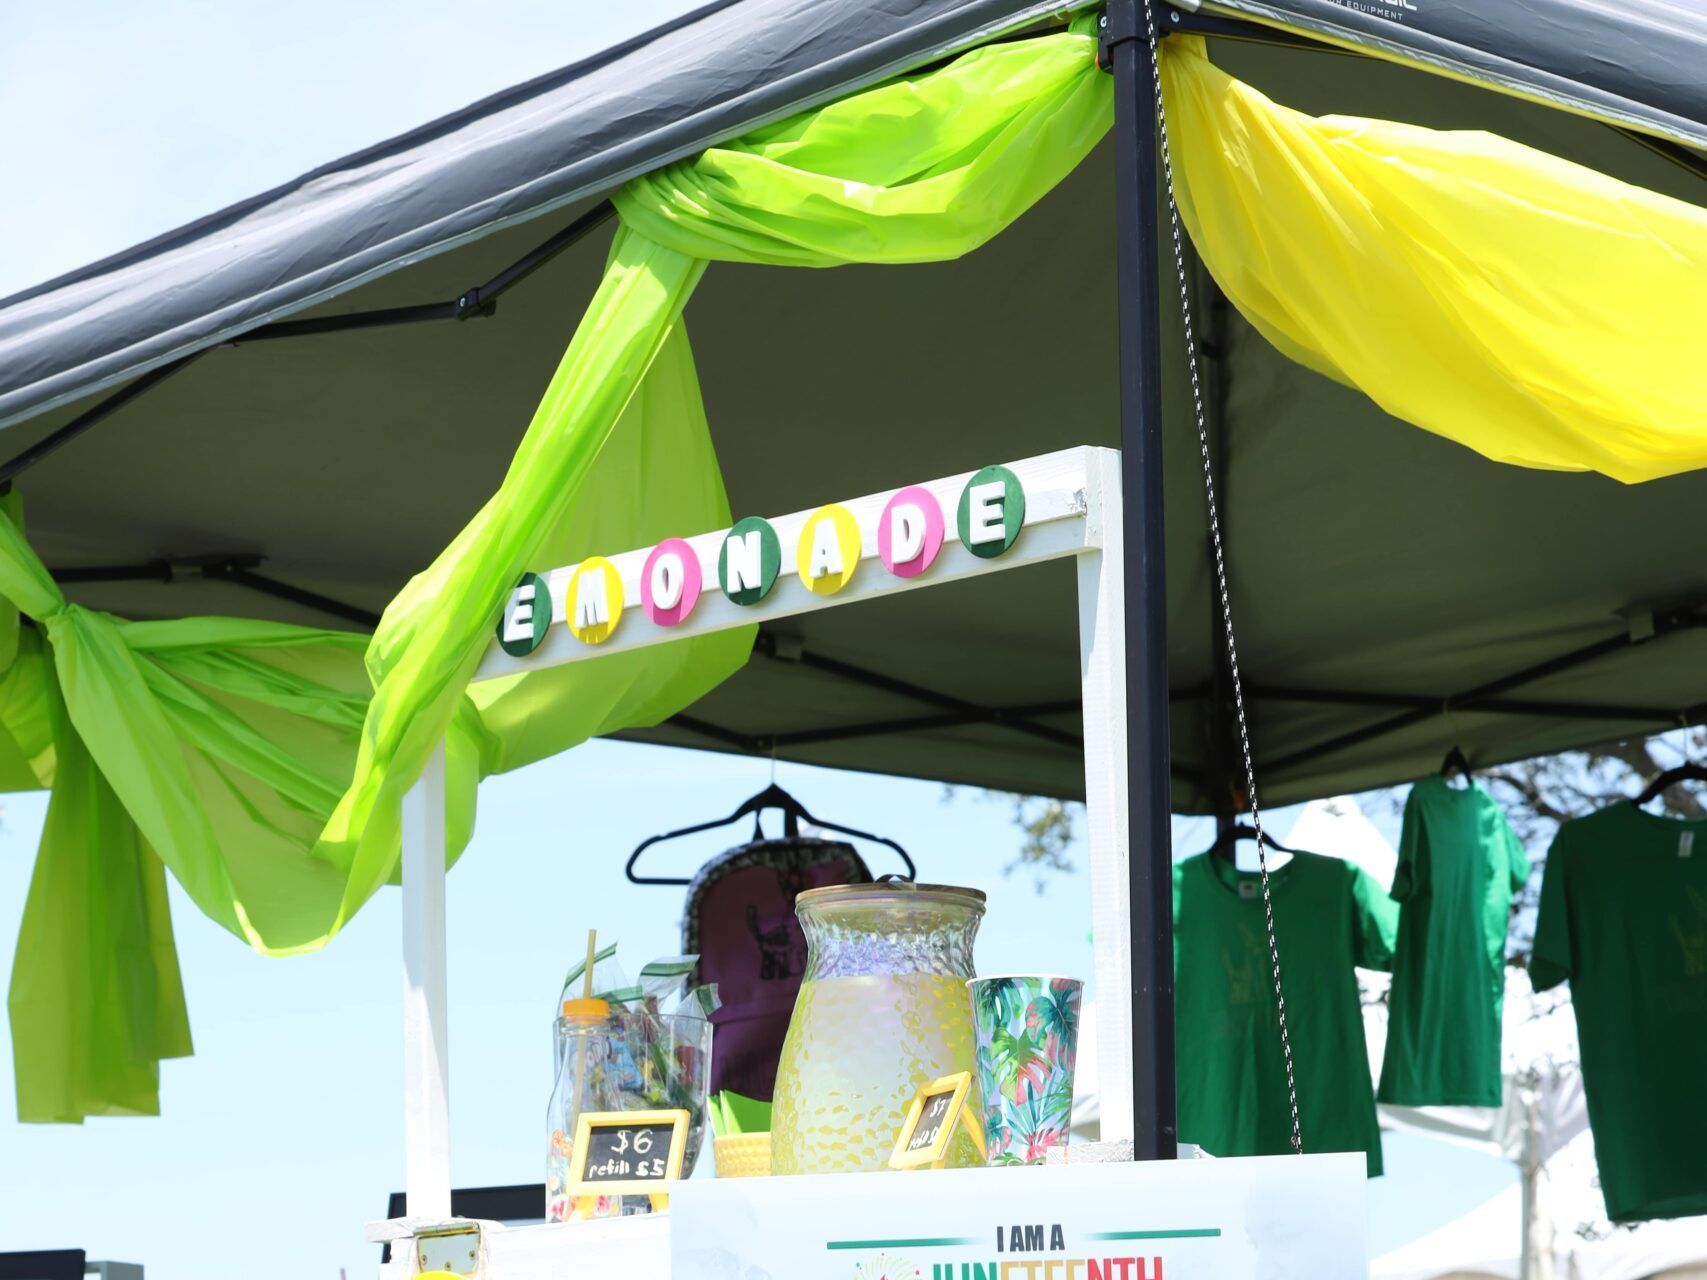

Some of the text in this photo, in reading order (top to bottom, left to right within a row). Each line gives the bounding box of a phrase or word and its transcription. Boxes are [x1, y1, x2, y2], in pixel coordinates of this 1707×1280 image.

[1346, 1, 1403, 20] EQUIPMENT
[610, 1128, 653, 1155] $6
[588, 1158, 666, 1179] refill $5
[996, 1223, 1066, 1253] I AM A
